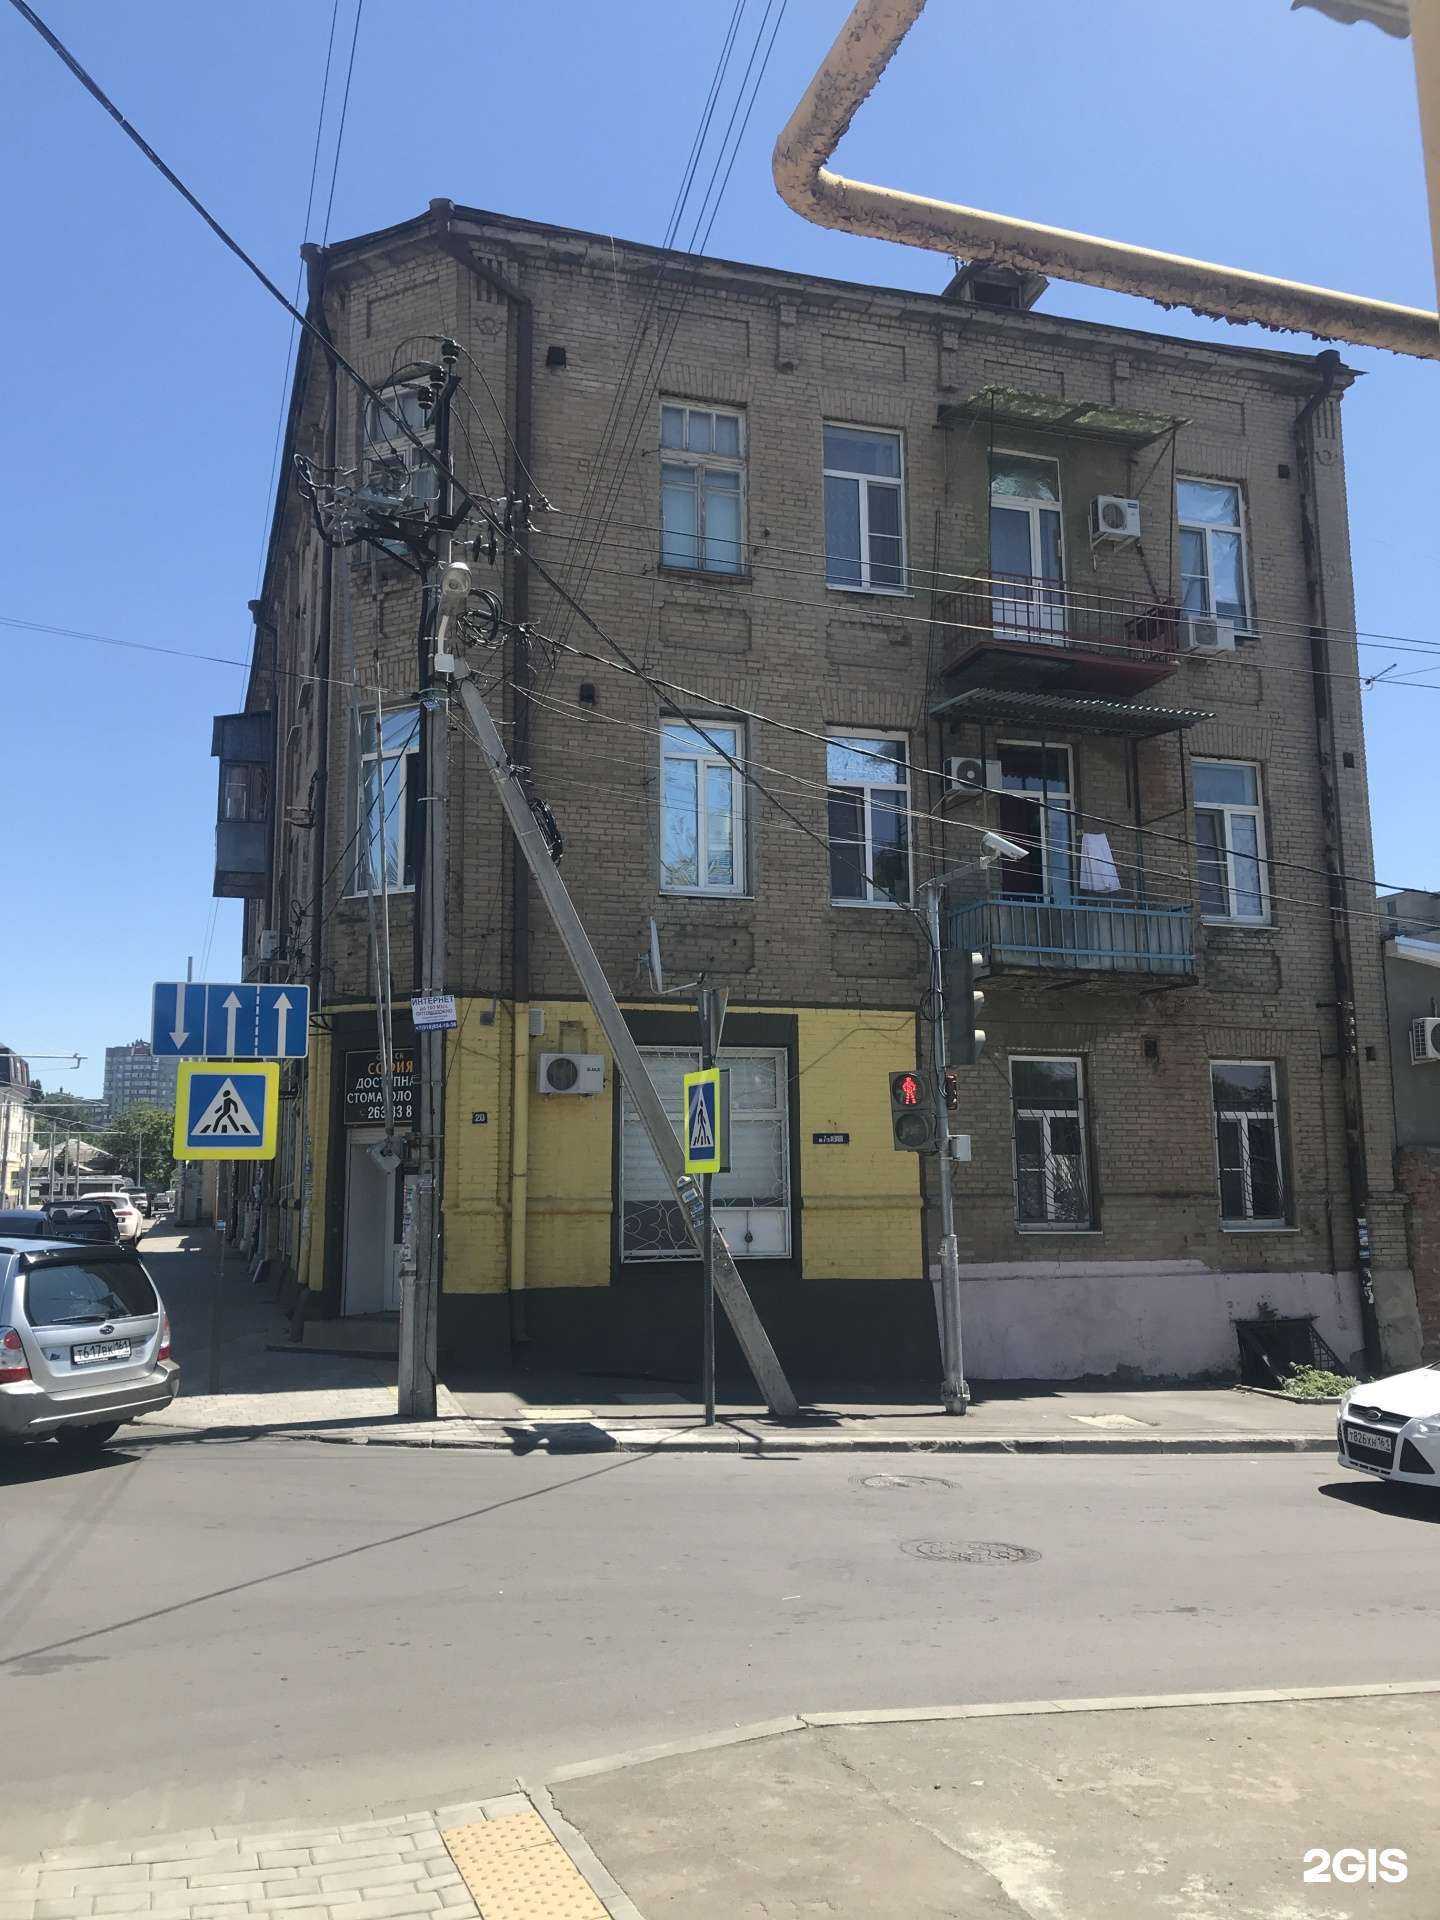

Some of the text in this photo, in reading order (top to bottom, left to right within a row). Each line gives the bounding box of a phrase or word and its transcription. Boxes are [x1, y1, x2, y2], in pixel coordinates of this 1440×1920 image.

[411, 996, 454, 1006] ИНТЕРНЕТ
[355, 1075, 414, 1090] ДОСТПН
[346, 1090, 412, 1104] СТОМАЛО
[475, 1114, 485, 1122] 20
